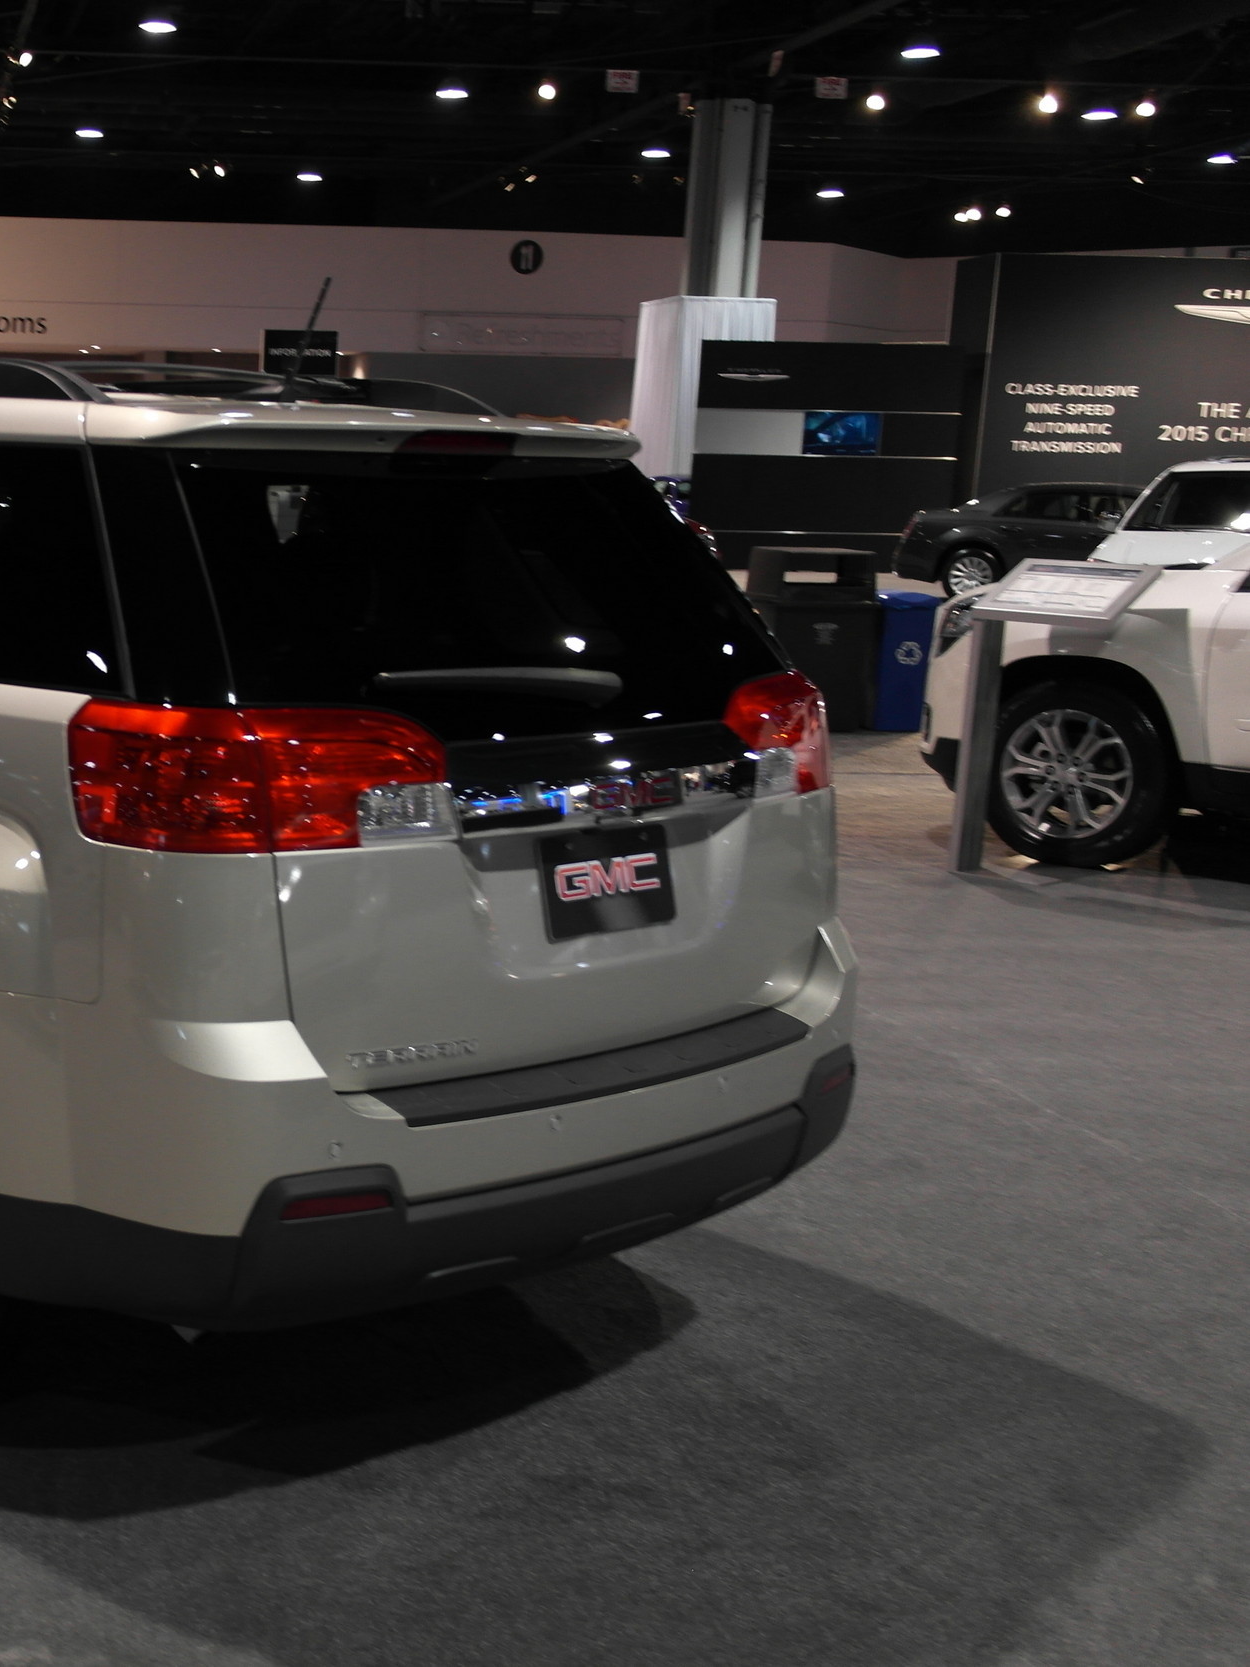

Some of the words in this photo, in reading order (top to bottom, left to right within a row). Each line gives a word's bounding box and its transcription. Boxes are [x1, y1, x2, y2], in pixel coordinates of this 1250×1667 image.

[1203, 288, 1250, 300] CH
[269, 347, 332, 358] INFORATION
[1005, 382, 1140, 398] CLASS-EXCLUSIVE
[1025, 402, 1116, 417] NINE-SPEED
[1198, 402, 1243, 420] THE
[1023, 421, 1113, 436] AUTOMATIC
[1157, 424, 1210, 443] 2015
[1010, 439, 1123, 454] TRANSMISSION
[589, 776, 672, 811] GMC
[554, 852, 662, 902] GMC
